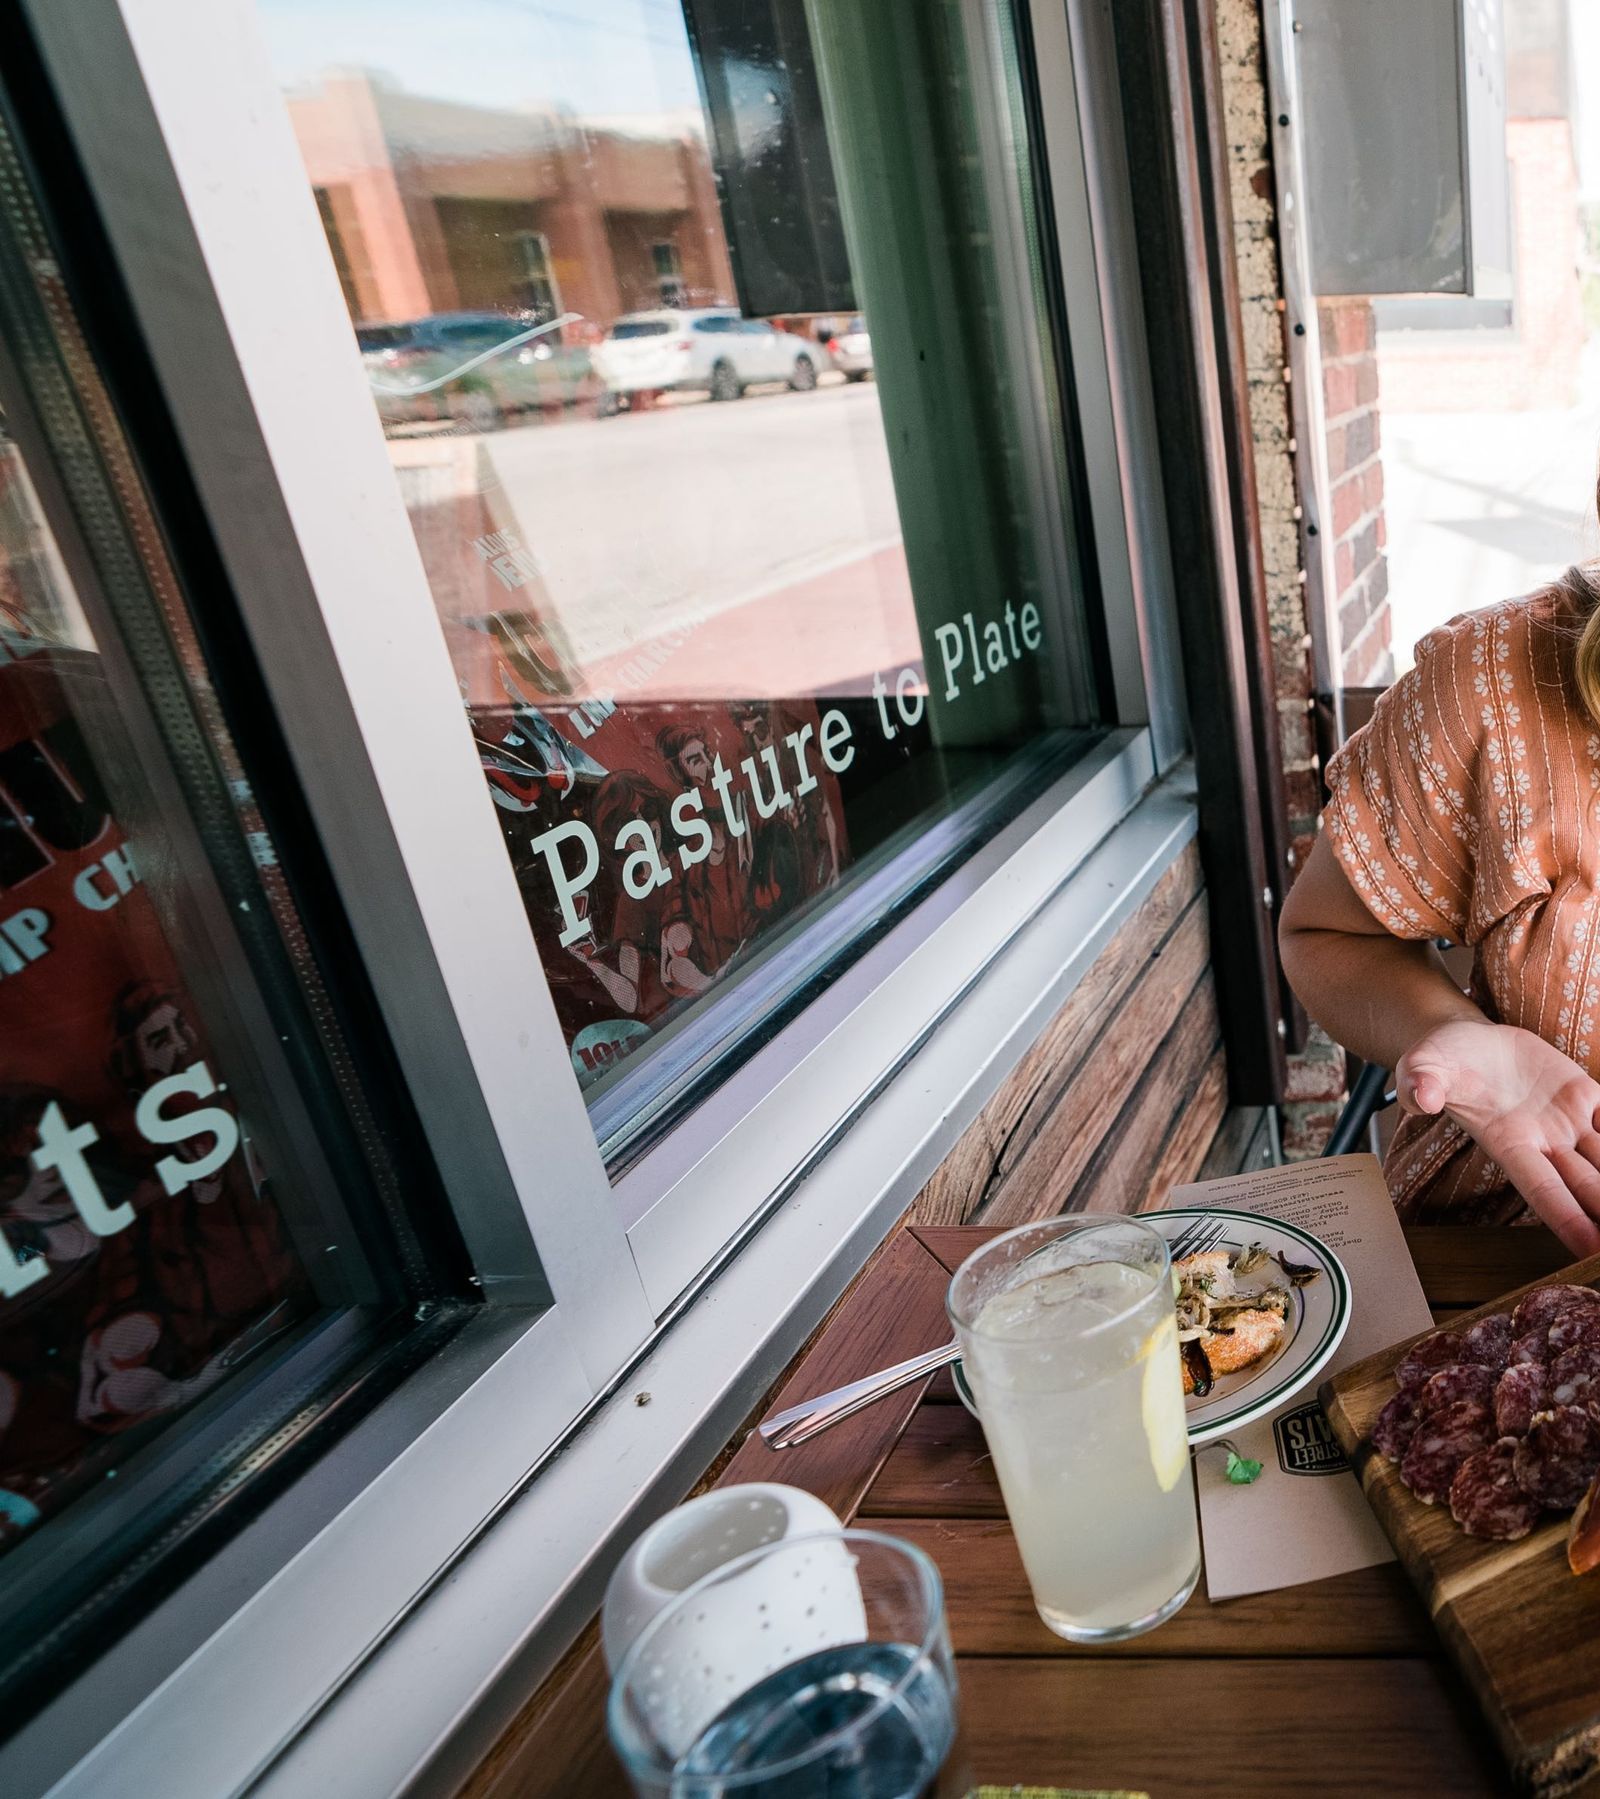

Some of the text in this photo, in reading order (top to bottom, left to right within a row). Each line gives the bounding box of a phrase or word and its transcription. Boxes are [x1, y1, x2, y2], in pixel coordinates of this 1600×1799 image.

[530, 599, 1041, 948] Pasture to Plate
[1288, 1414, 1333, 1450] ATS
[1295, 1441, 1340, 1467] STREET
